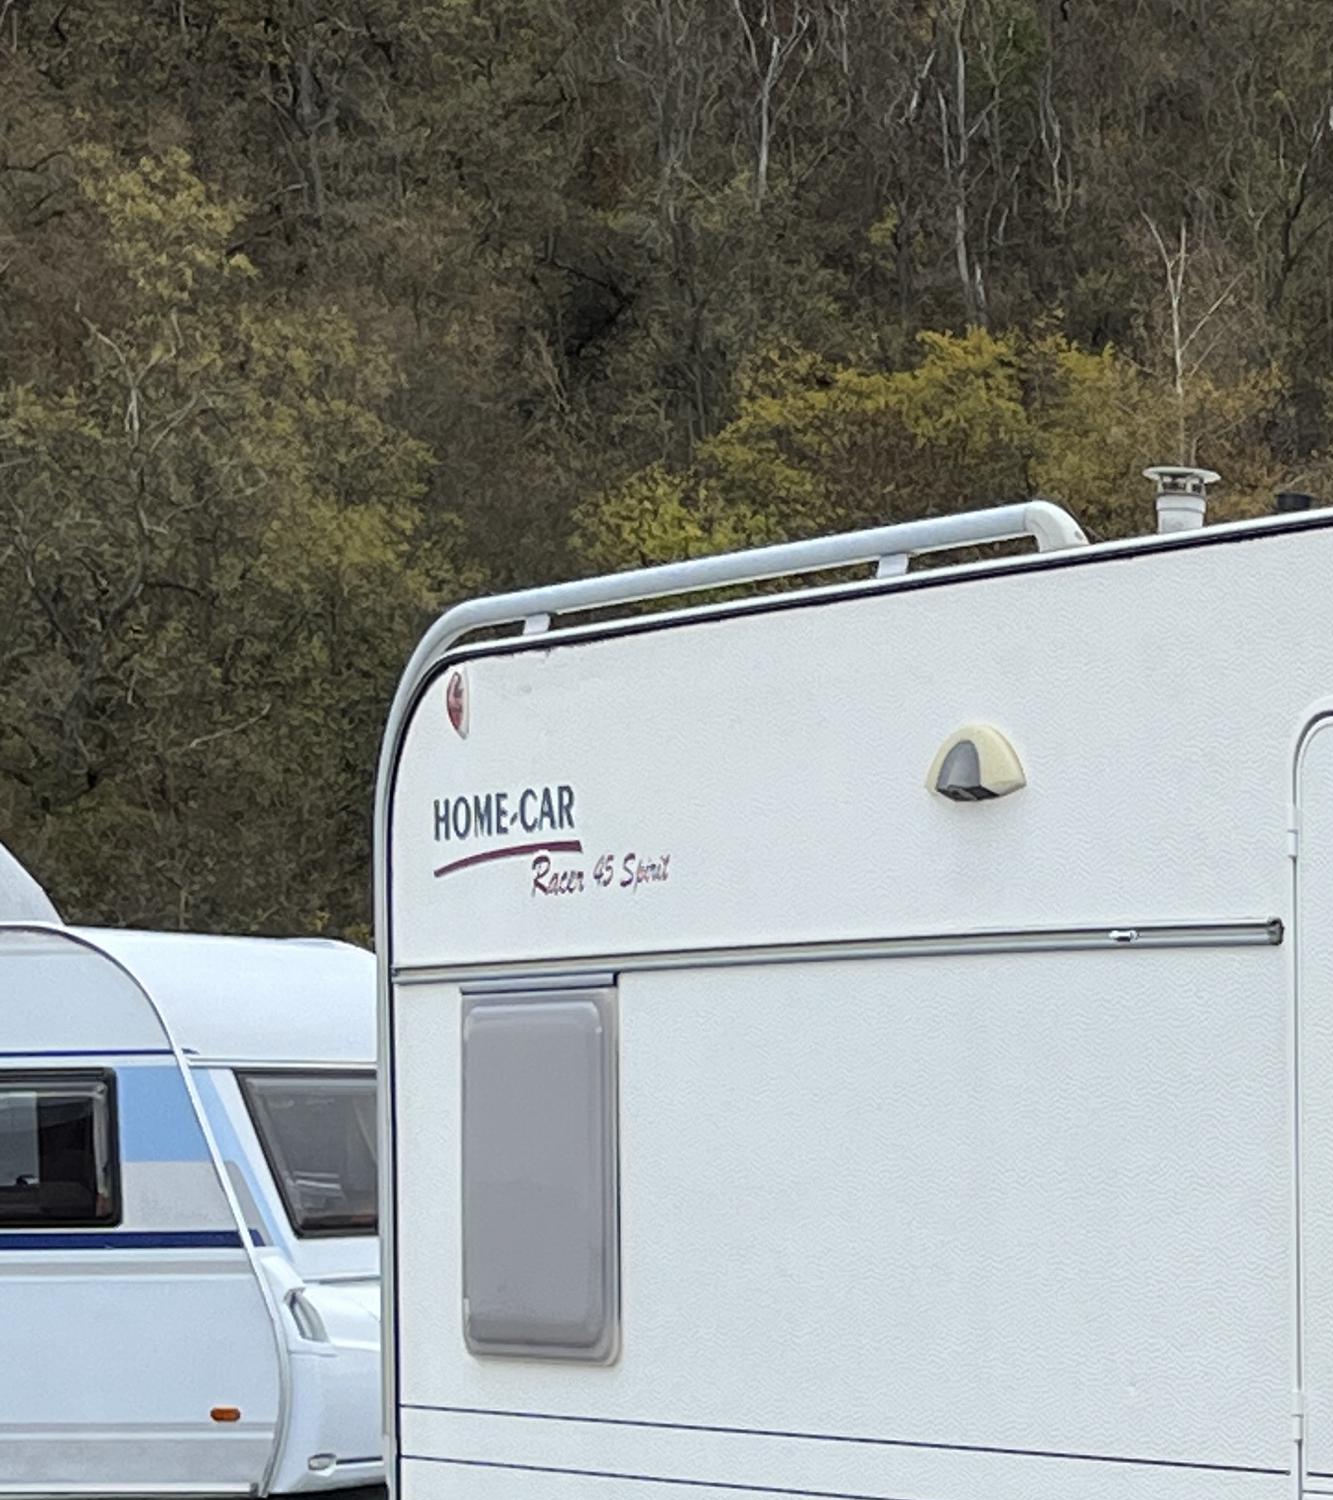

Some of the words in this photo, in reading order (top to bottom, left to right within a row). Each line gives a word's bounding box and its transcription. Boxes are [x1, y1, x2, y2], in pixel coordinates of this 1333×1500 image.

[434, 785, 575, 841] HOME-CAR
[532, 855, 584, 897] Racer
[592, 855, 614, 887] 45
